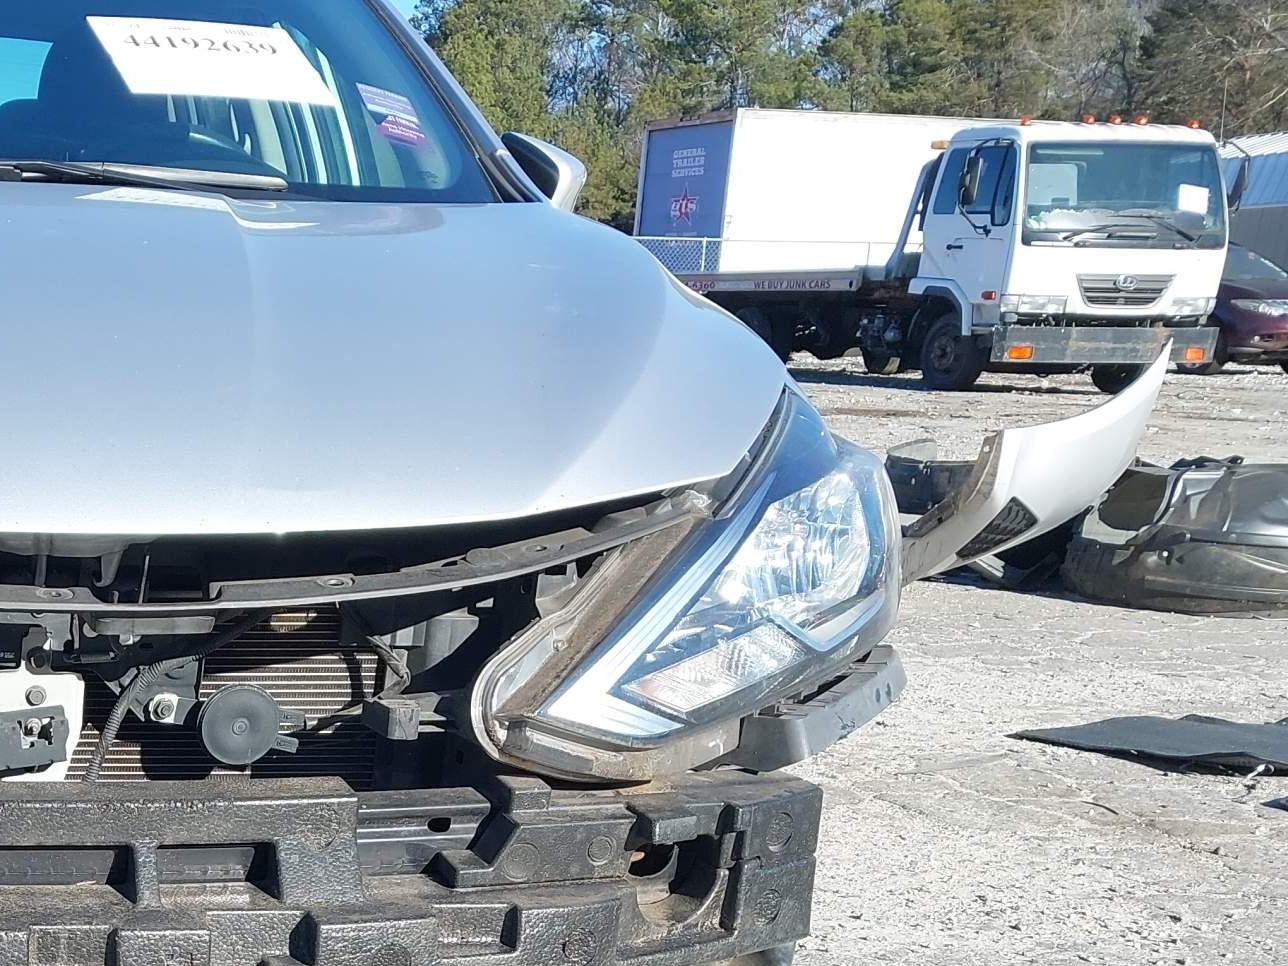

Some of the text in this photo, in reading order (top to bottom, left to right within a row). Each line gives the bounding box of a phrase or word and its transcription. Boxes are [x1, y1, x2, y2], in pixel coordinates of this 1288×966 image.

[123, 34, 278, 54] 44192639
[673, 147, 706, 158] GENERAL
[673, 157, 705, 168] TRAILER
[672, 167, 705, 177] SERVICES
[753, 280, 831, 289] WE BUY JUNK CARS
